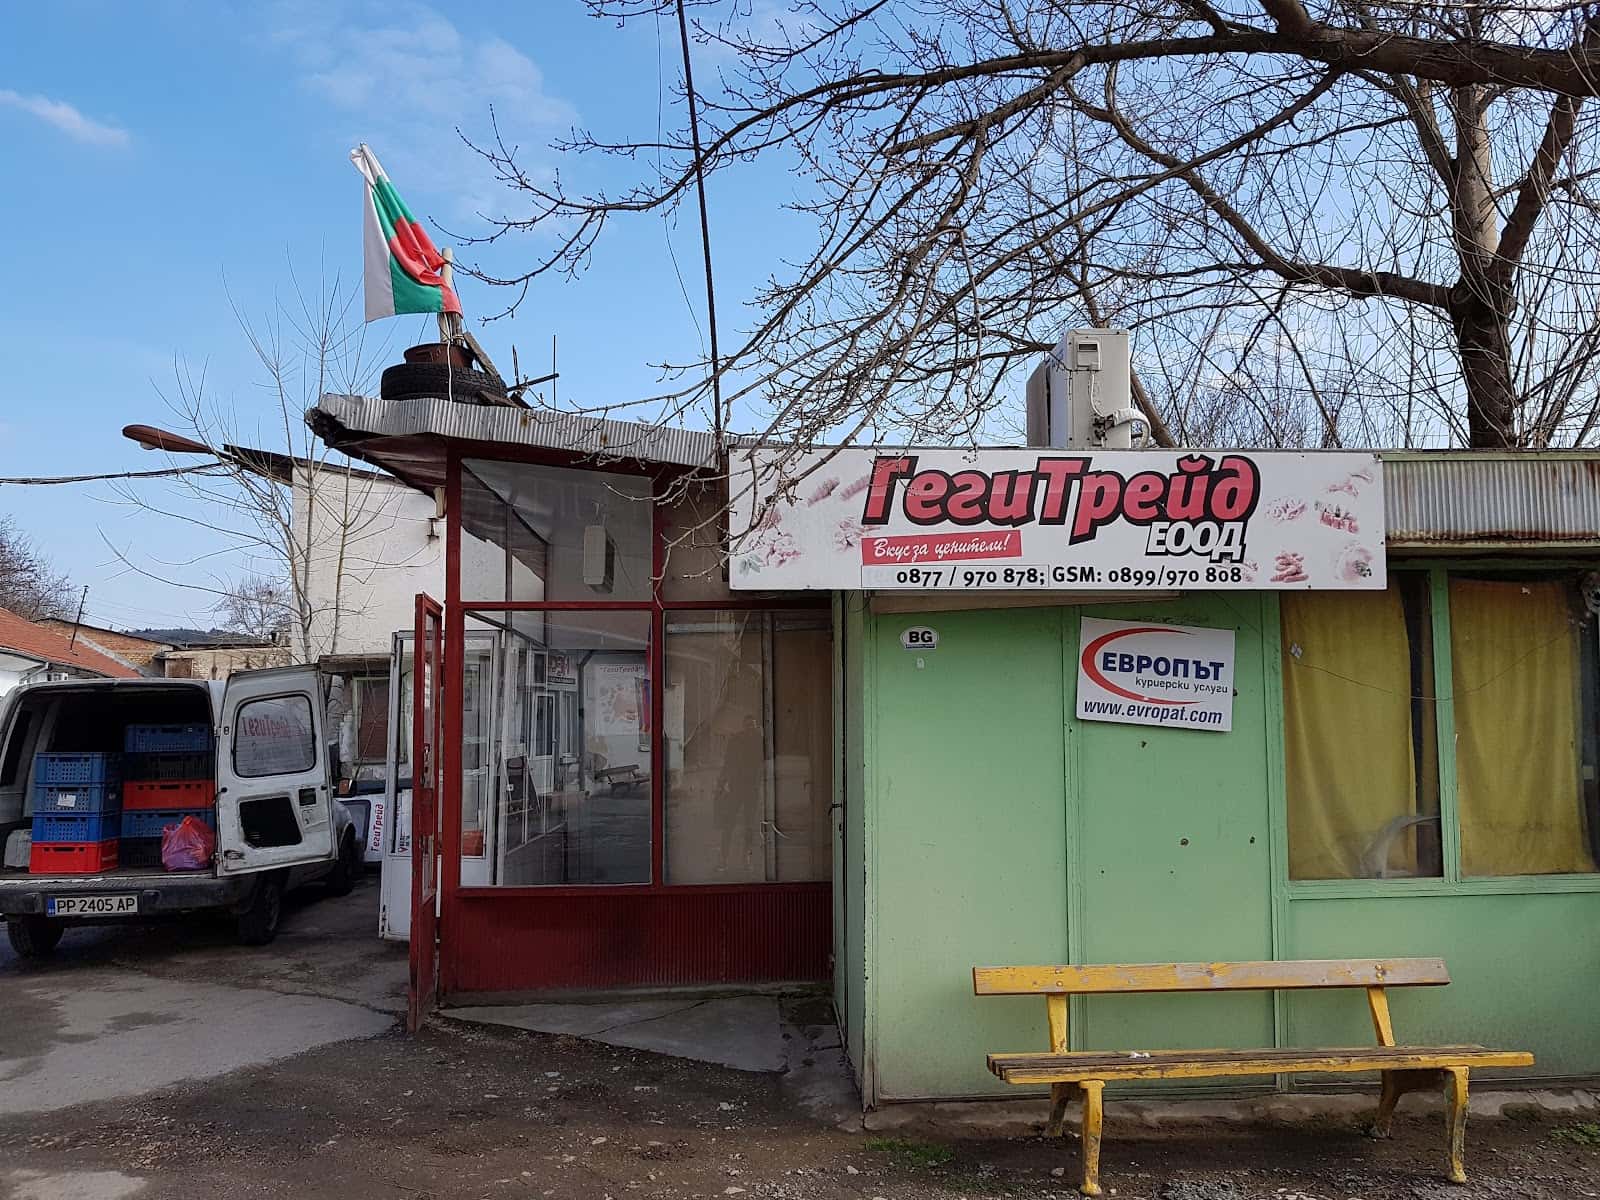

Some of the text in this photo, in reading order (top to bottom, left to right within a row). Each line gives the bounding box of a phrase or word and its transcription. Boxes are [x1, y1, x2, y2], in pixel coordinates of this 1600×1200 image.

[861, 454, 1260, 545] ГегиТрейд
[873, 533, 1011, 563] Вкус за ценители!
[1145, 521, 1246, 563] ЕООД
[896, 568, 943, 587] 0877
[963, 571, 997, 587] 970
[1003, 568, 1045, 587] 878;
[1052, 566, 1102, 583] GSM:
[1108, 565, 1199, 586] 0899/970
[1205, 567, 1242, 583] 808
[908, 630, 933, 643] BG
[1102, 652, 1225, 681] ЕВРОПЪТ
[1135, 676, 1228, 695] куриерски услуги
[1084, 700, 1222, 724] www.evropat.com
[57, 897, 135, 913] PP 2405 AP
